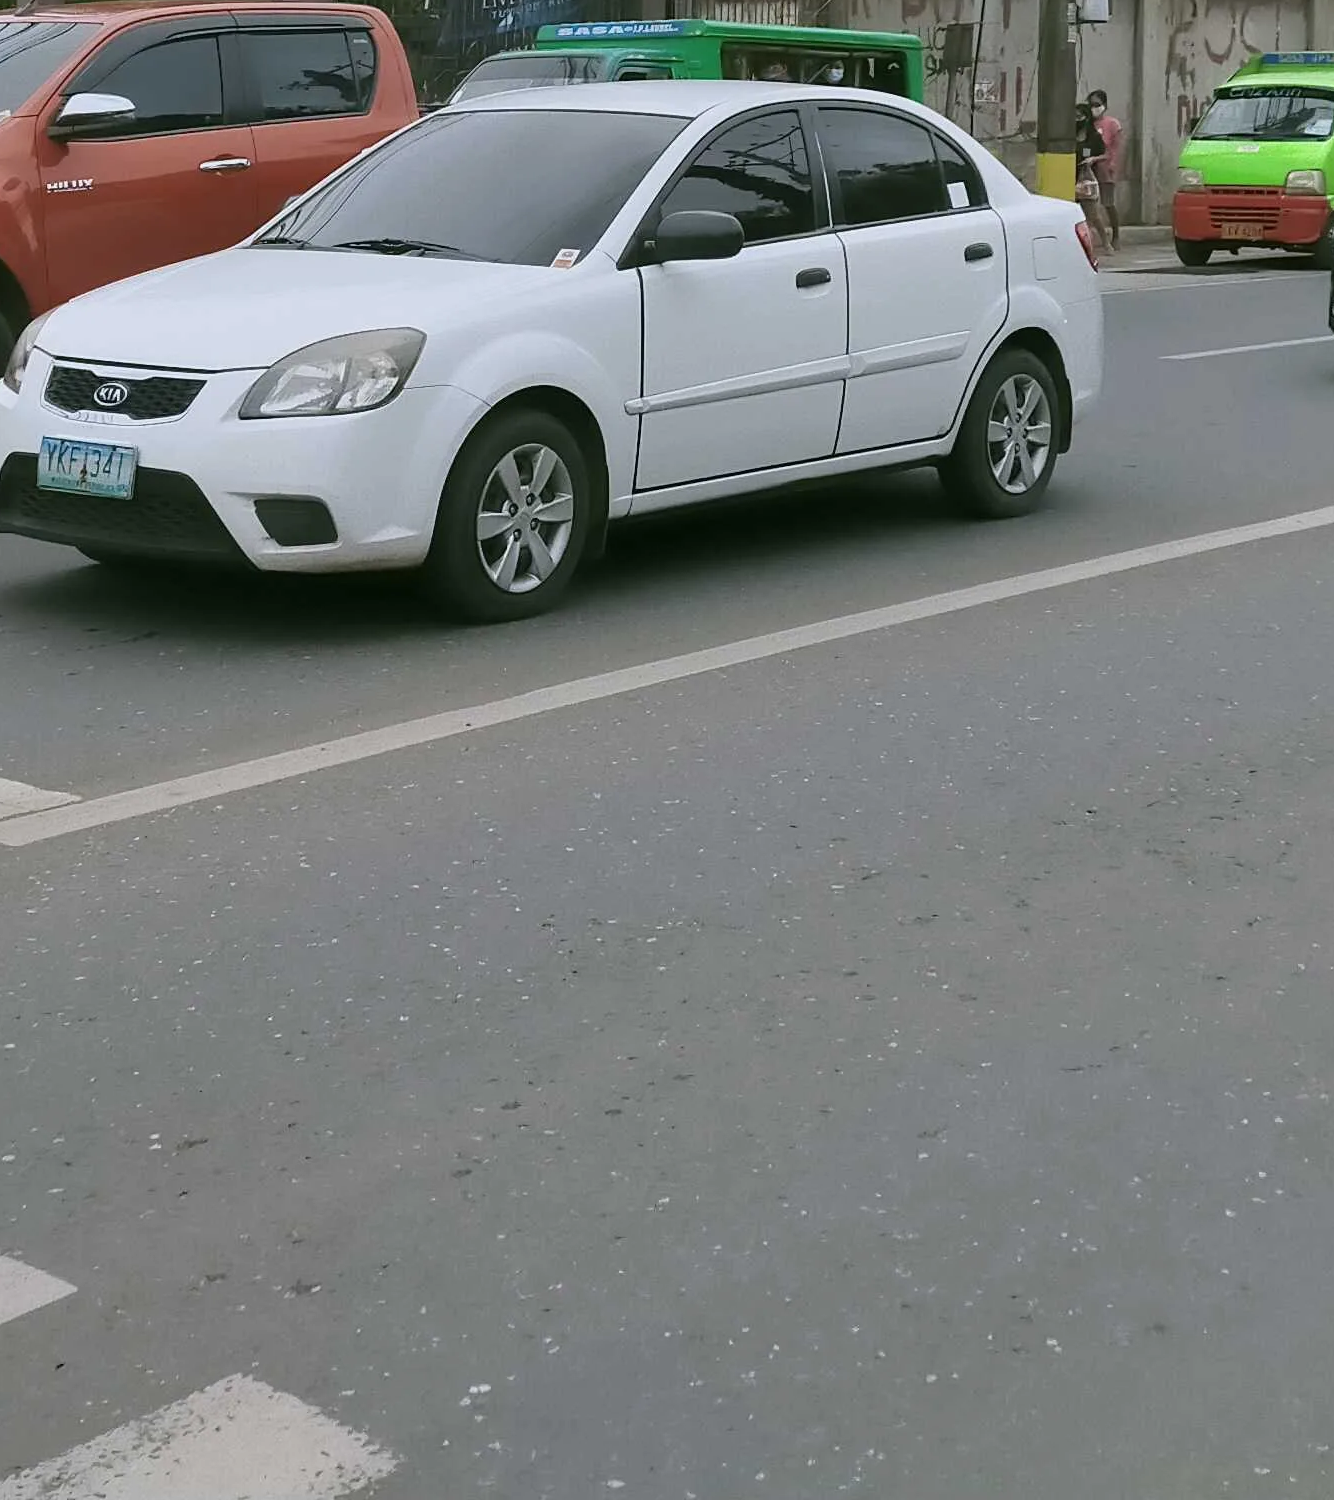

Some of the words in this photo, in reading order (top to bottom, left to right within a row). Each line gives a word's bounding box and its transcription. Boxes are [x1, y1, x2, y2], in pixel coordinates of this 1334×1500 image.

[557, 24, 624, 36] SASA
[46, 178, 94, 191] HILUX
[99, 387, 121, 402] KIA
